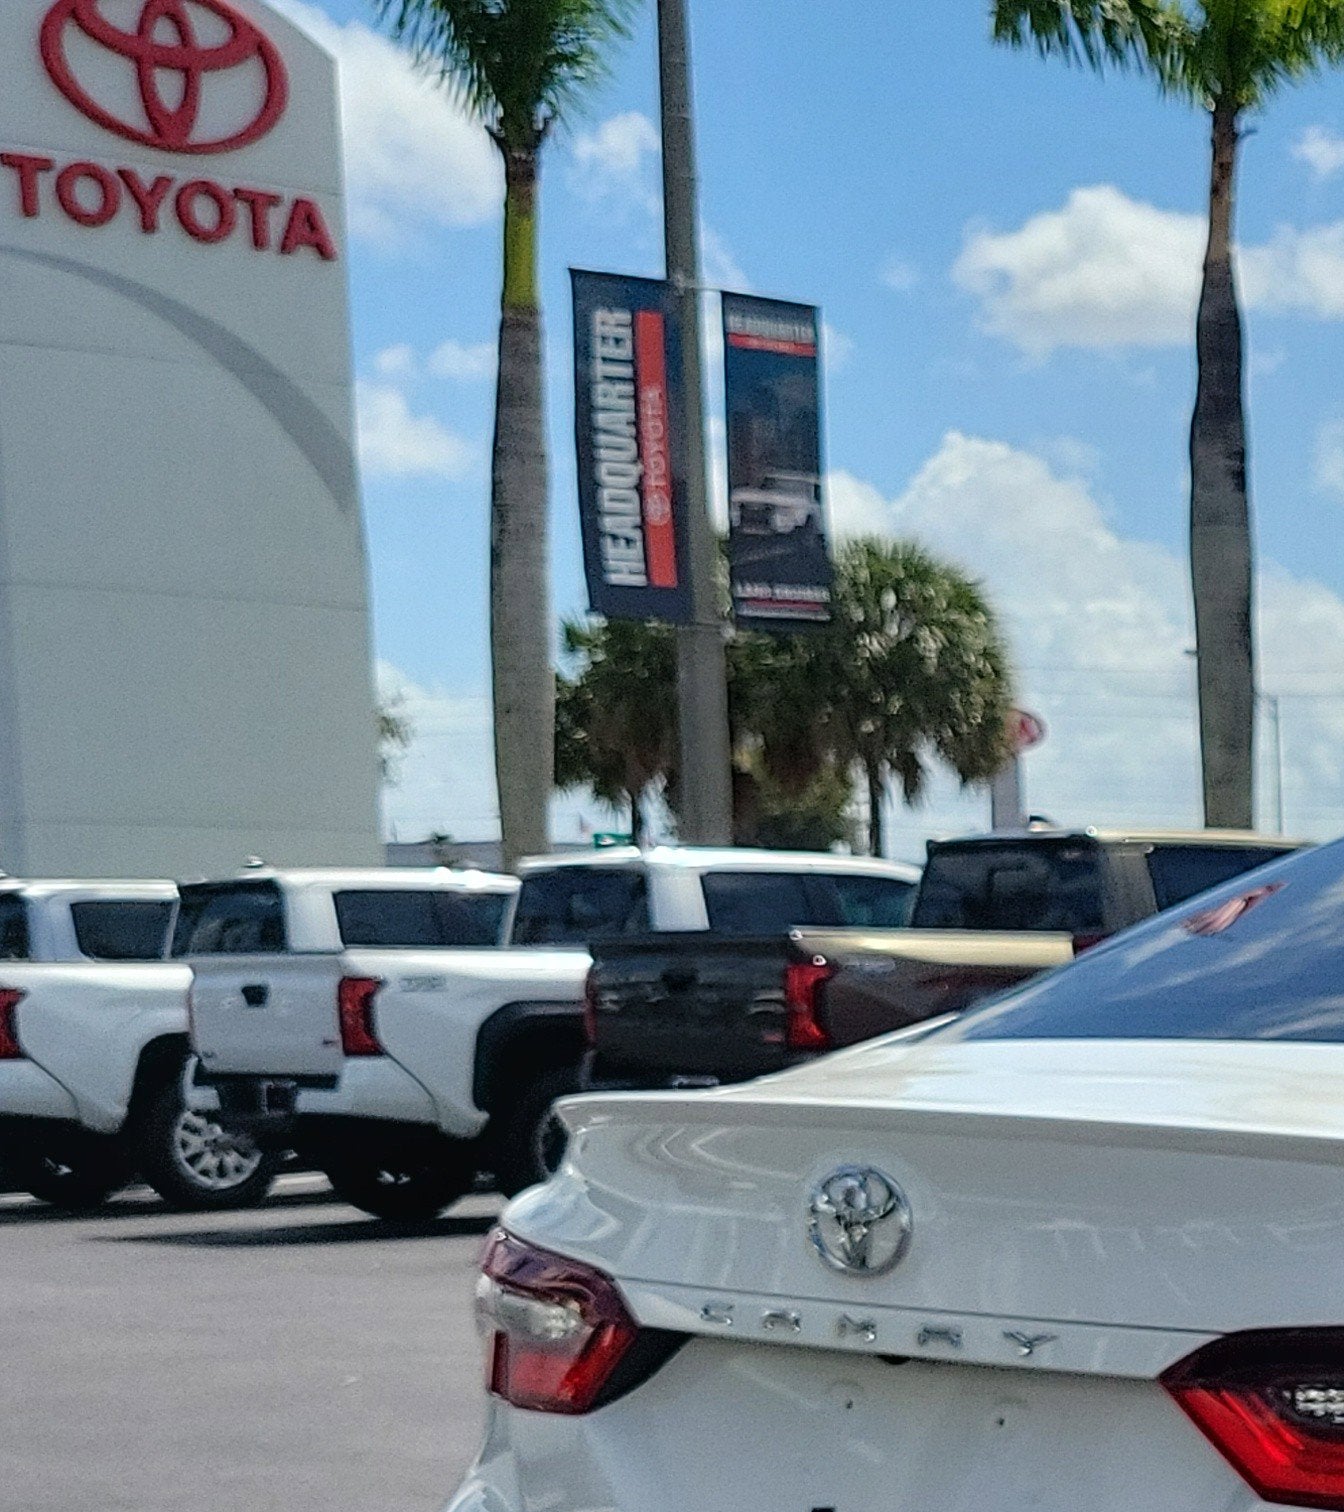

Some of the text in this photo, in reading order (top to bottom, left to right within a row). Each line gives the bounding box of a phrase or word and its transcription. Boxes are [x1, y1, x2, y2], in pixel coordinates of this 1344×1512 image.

[1, 152, 337, 261] TOYOTA
[591, 308, 648, 588] HEADQUARTER
[700, 1301, 1058, 1355] CAMRY
